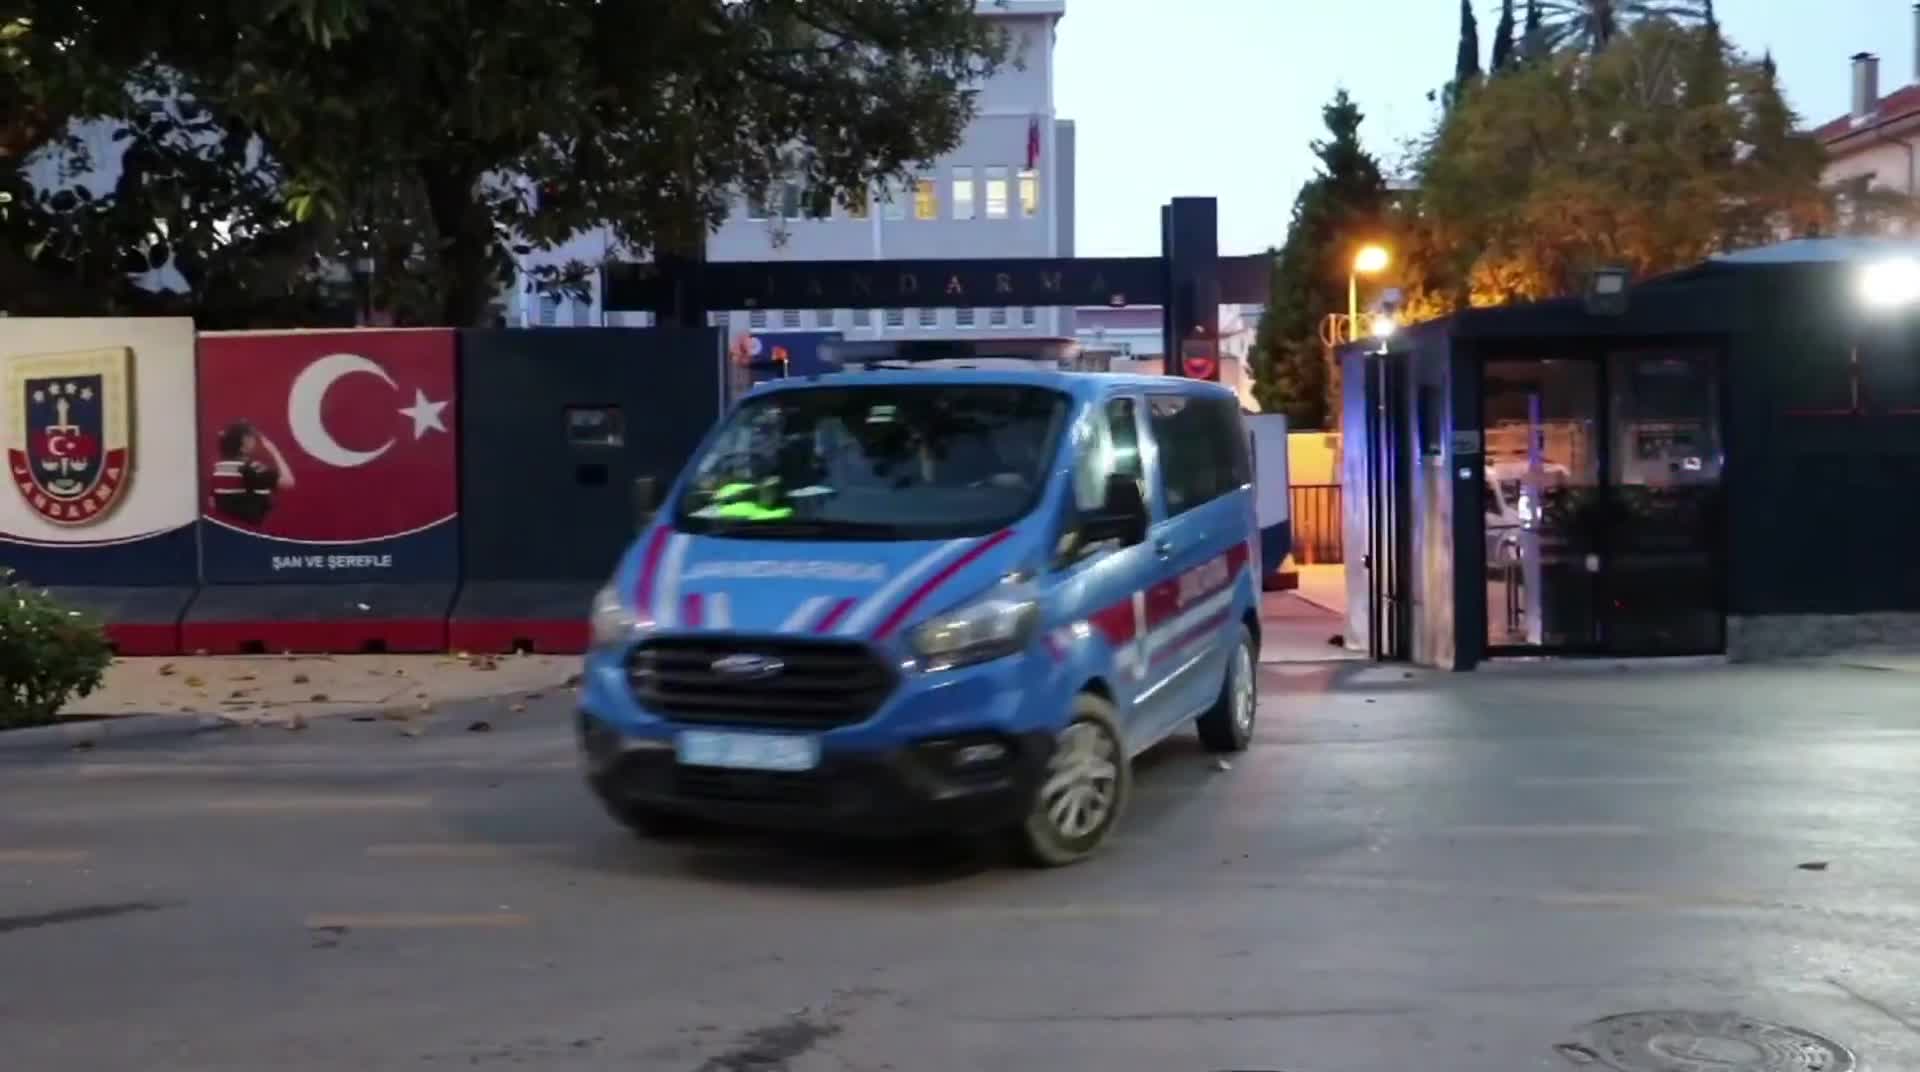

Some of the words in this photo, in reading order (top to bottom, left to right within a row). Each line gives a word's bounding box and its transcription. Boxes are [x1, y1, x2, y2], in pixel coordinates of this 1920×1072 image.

[13, 465, 120, 518] JANDARMA
[272, 555, 302, 571] ŞAN
[304, 555, 325, 568] VE
[327, 554, 392, 571] ŞEREFLE
